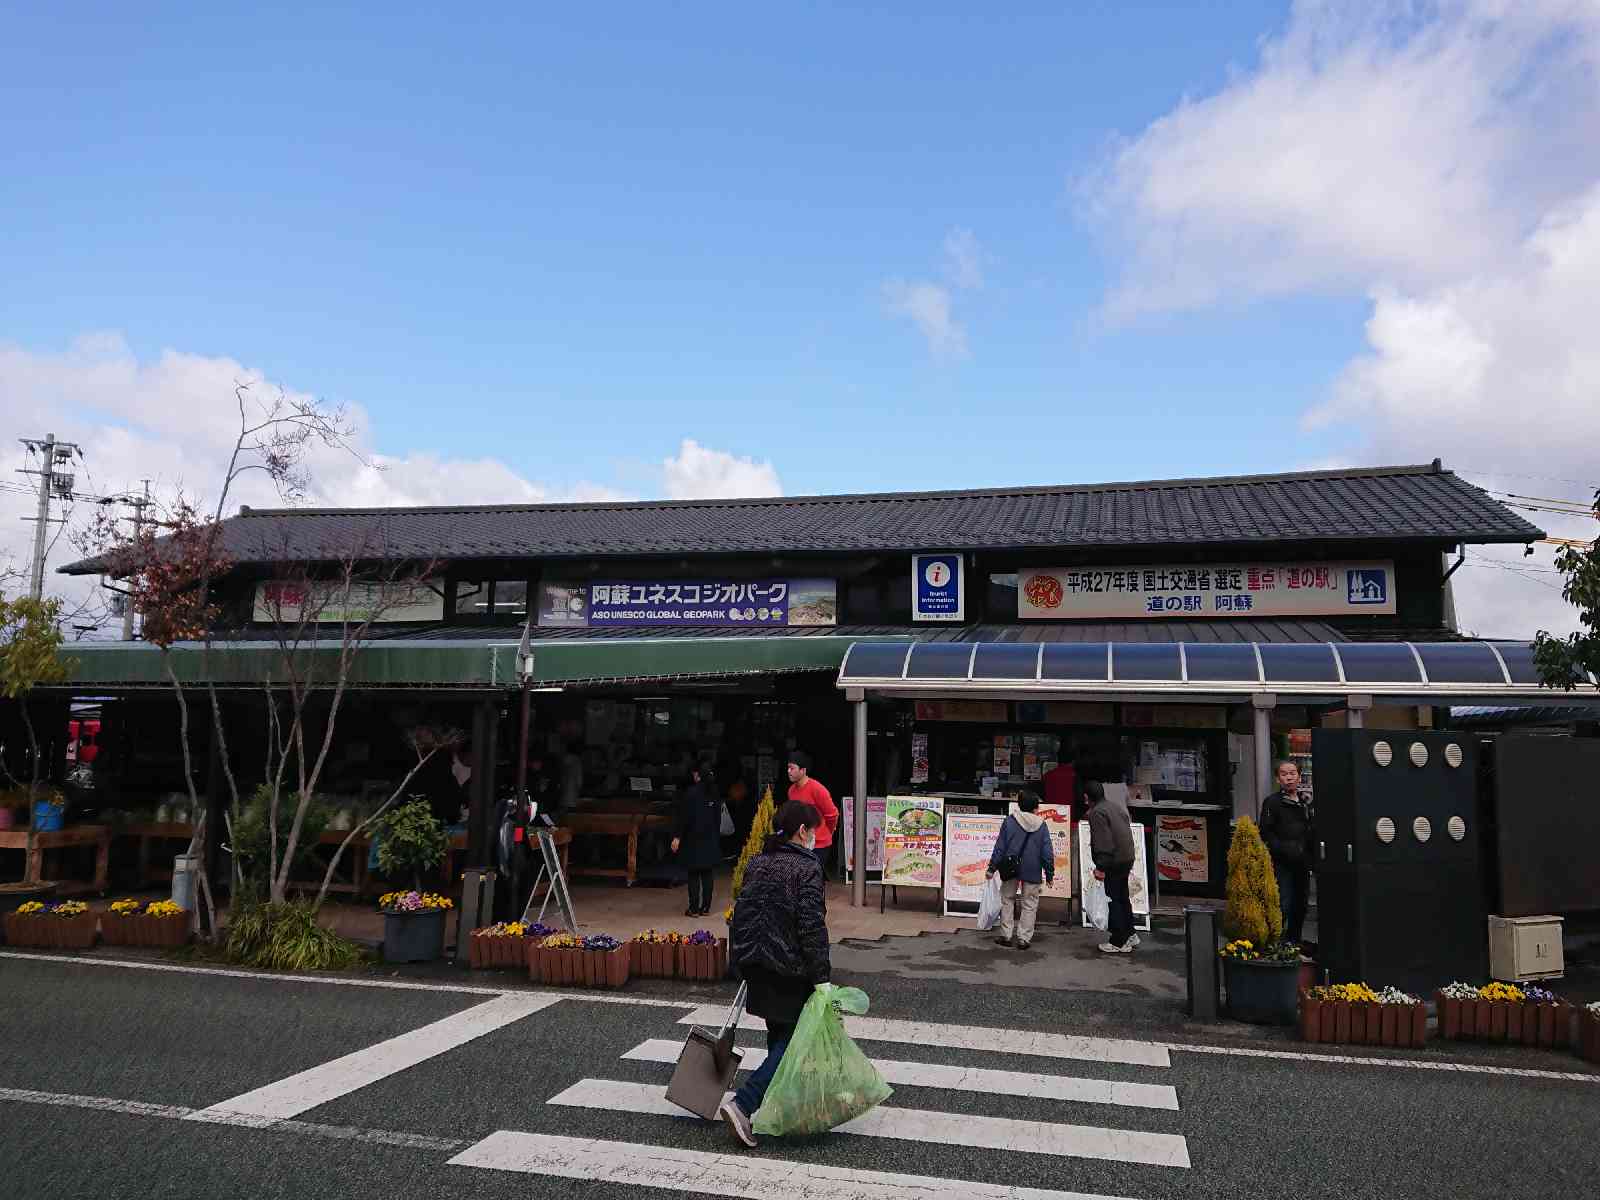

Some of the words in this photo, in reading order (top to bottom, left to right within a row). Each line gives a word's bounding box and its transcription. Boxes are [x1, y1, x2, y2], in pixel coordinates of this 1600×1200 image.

[1068, 571, 1139, 593] 平成27年度
[1143, 569, 1210, 592] 国土交通省
[1215, 568, 1242, 590] 選定
[592, 584, 787, 604] 阿蘇ユネスコジオパーク
[1147, 595, 1202, 612] 道の駅
[1215, 594, 1253, 611] 阿蘇
[591, 611, 610, 619] ASO
[611, 610, 645, 619] UNESCO
[646, 610, 681, 619] GLOBAL
[683, 609, 725, 619] GEOPARK
